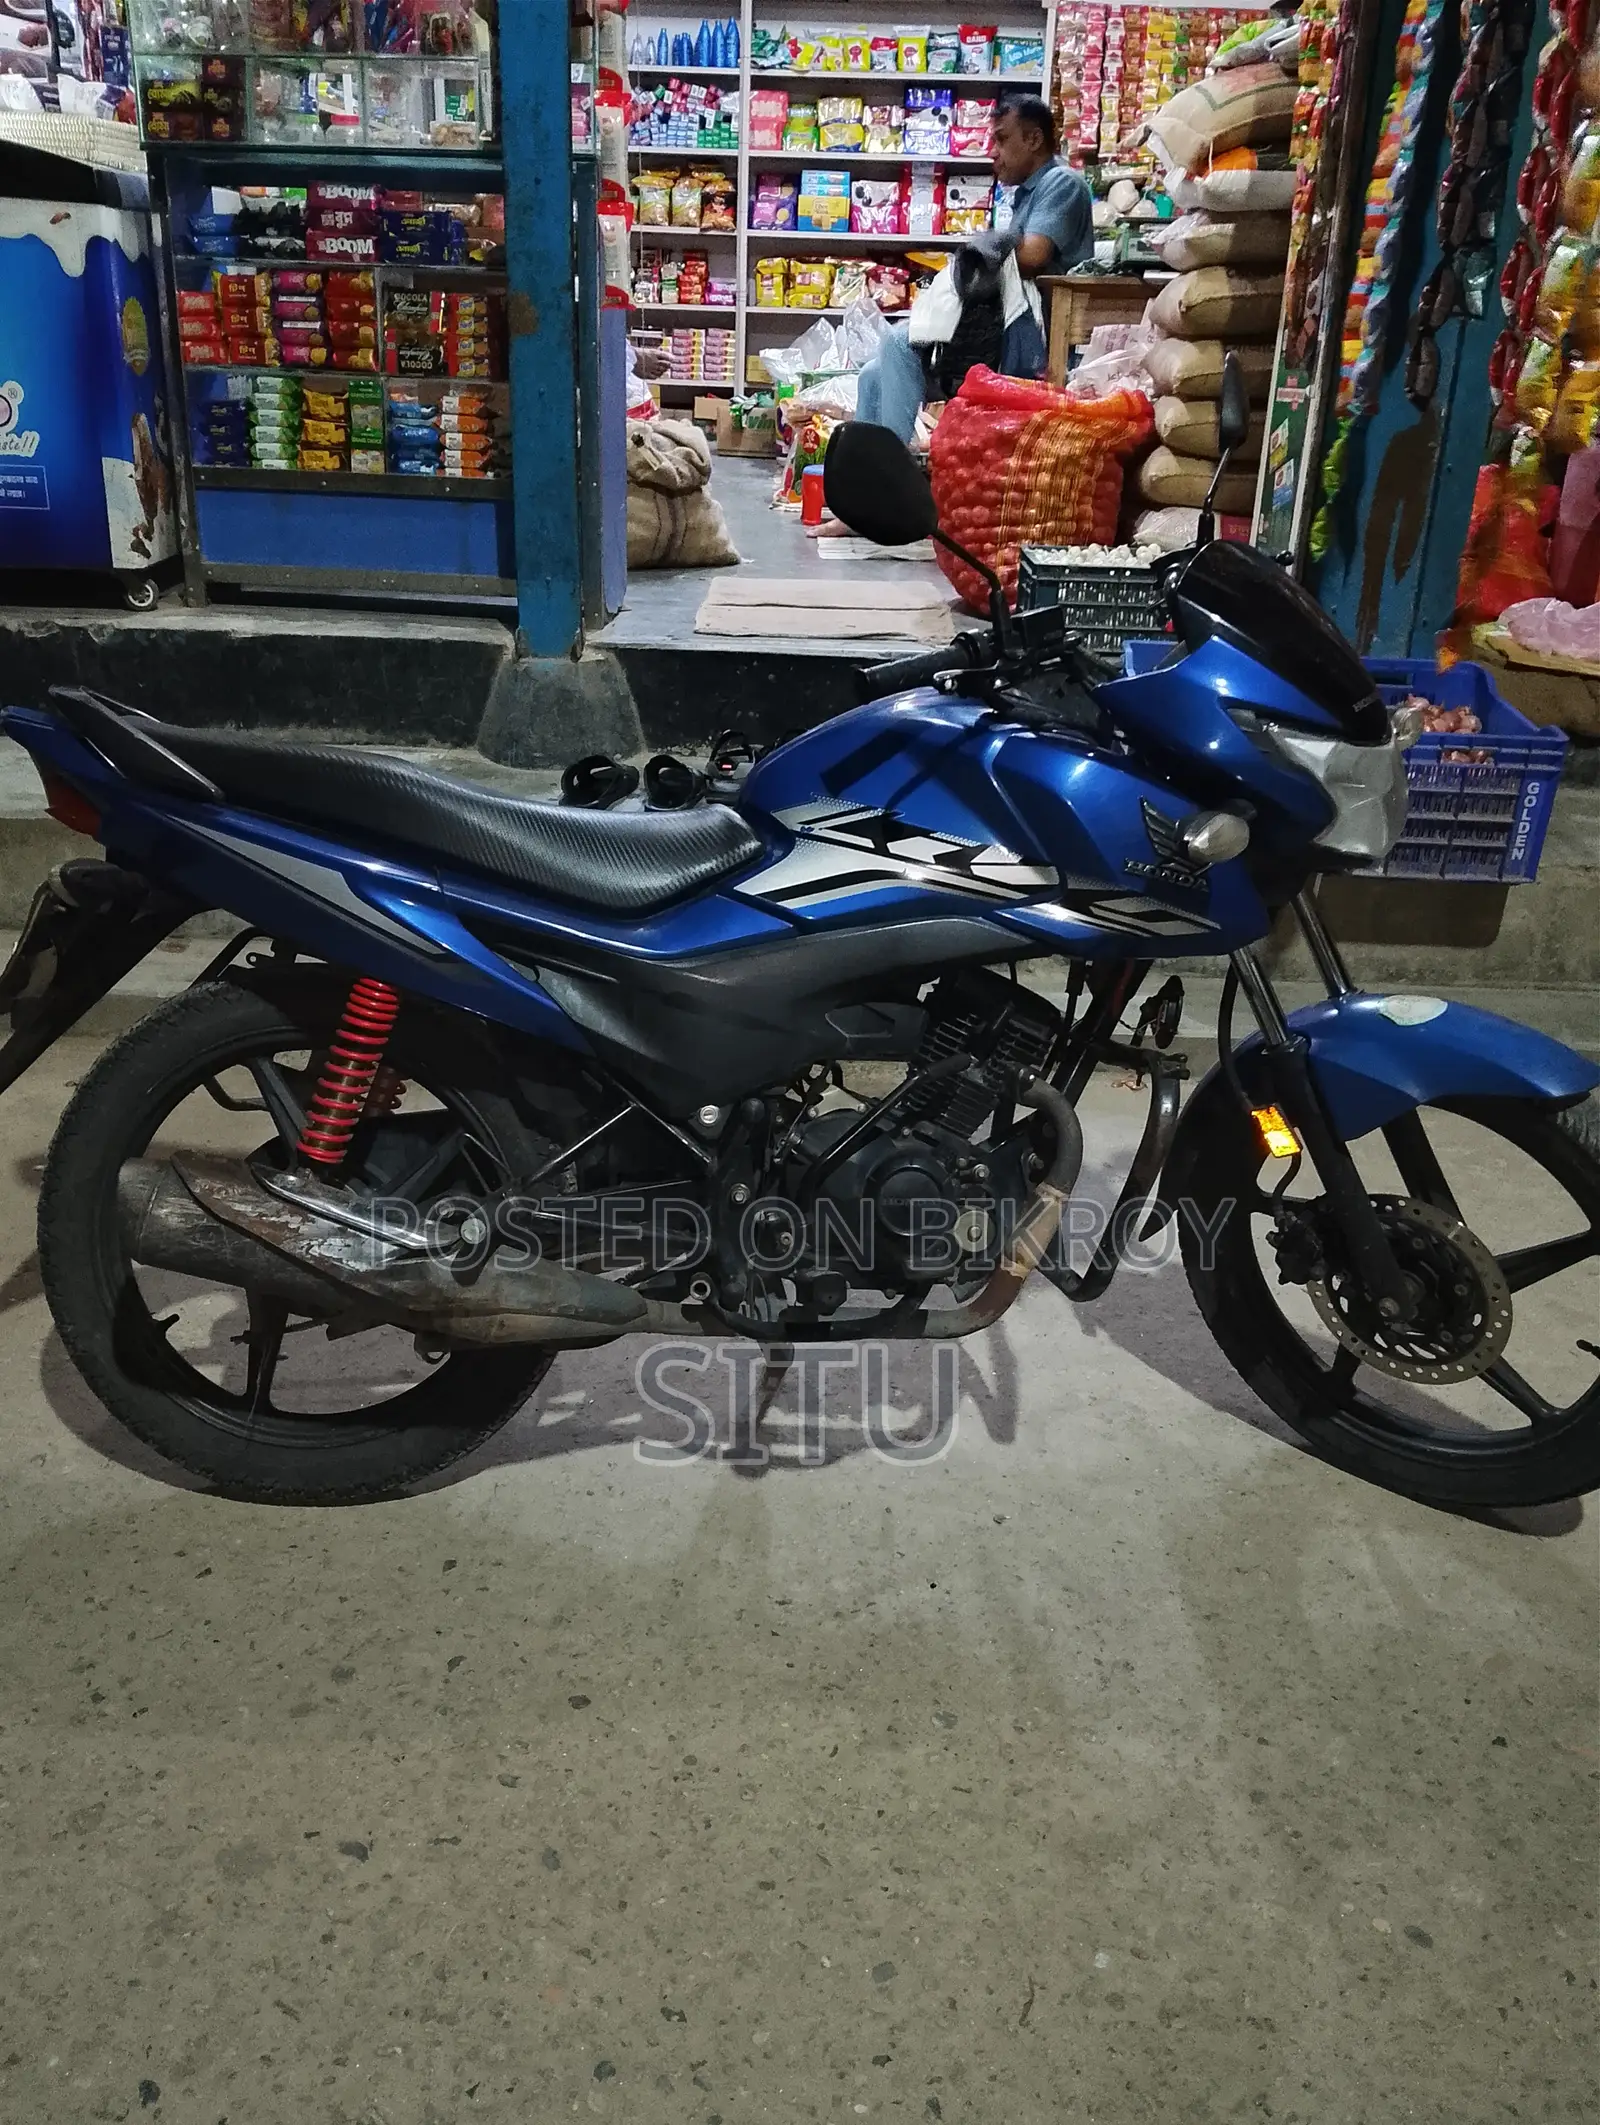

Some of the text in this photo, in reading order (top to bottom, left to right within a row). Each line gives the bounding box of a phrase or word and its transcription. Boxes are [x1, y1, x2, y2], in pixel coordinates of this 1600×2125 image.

[325, 185, 376, 200] BOOM
[325, 237, 375, 254] BOOM
[394, 293, 428, 302] COCOLA
[400, 360, 433, 370] COCOLA
[1511, 782, 1541, 861] GOLDEN
[1124, 857, 1209, 892] HONDA
